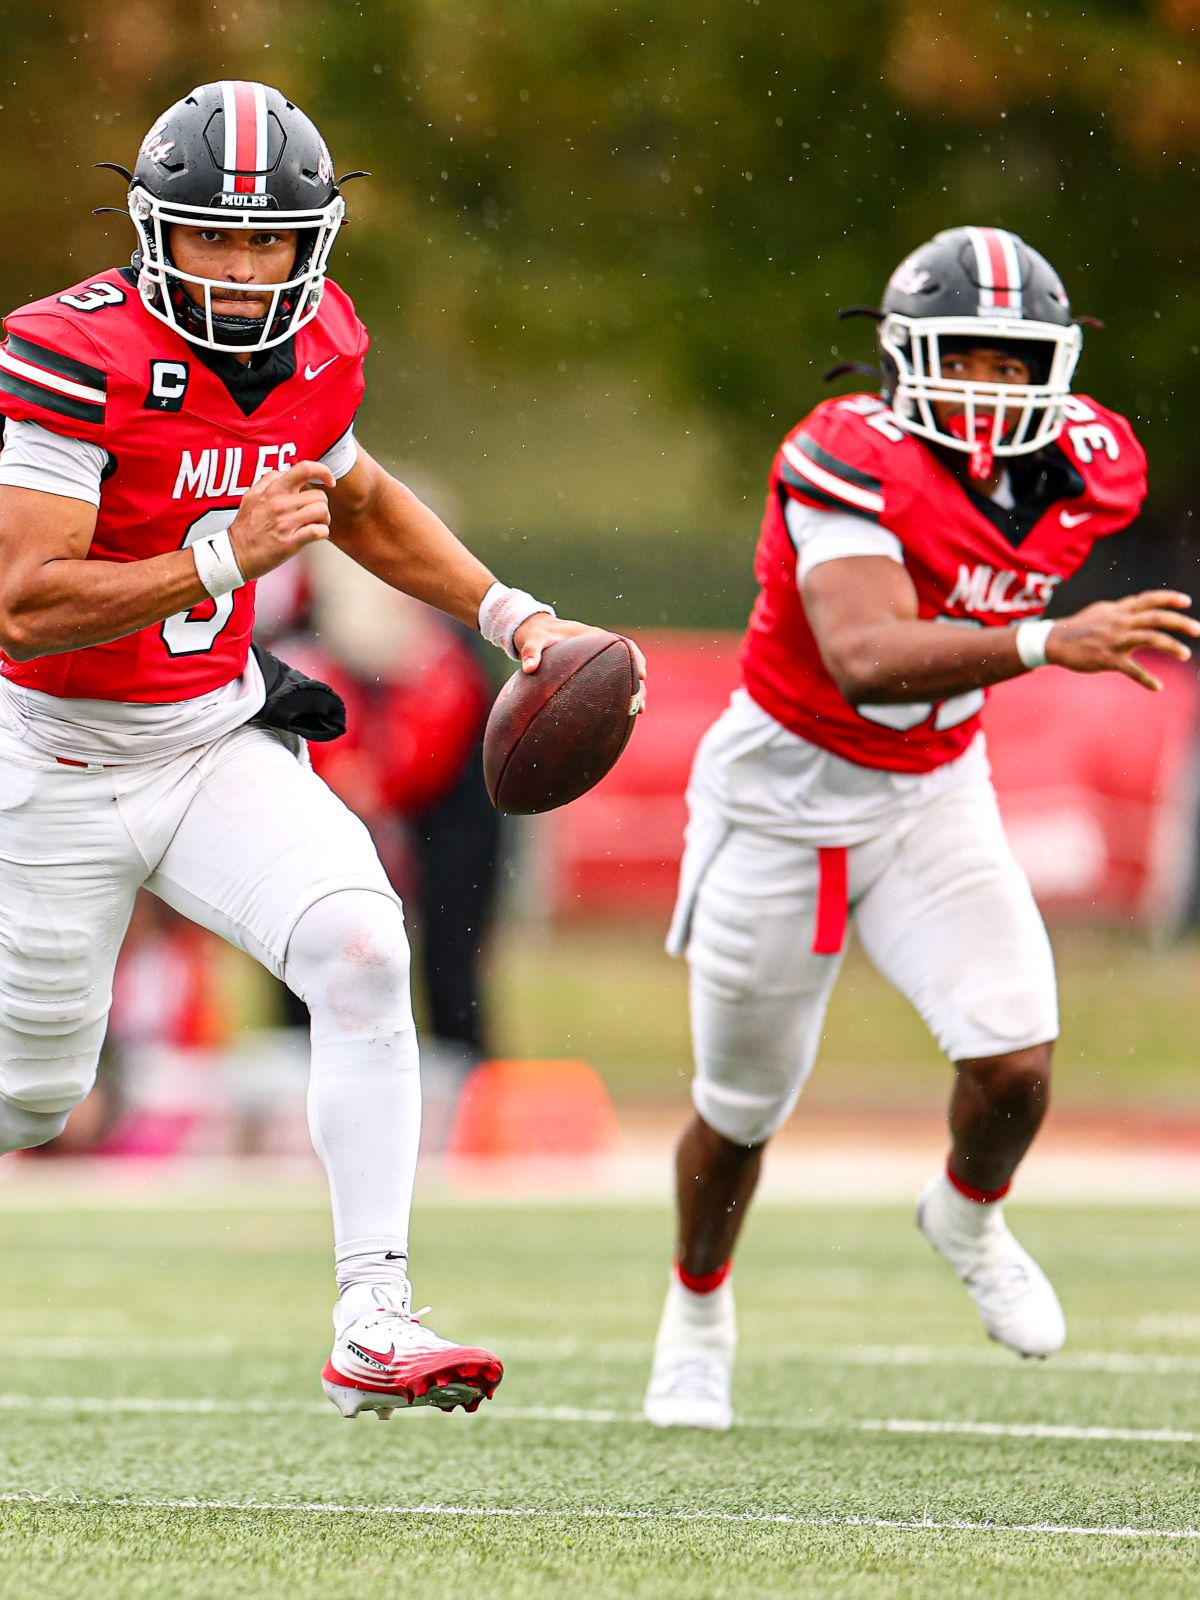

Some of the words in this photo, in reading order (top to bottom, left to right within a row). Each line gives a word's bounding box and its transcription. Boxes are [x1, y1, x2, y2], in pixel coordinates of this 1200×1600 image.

[221, 194, 268, 207] MULES
[57, 282, 127, 313] 3
[153, 362, 186, 399] C
